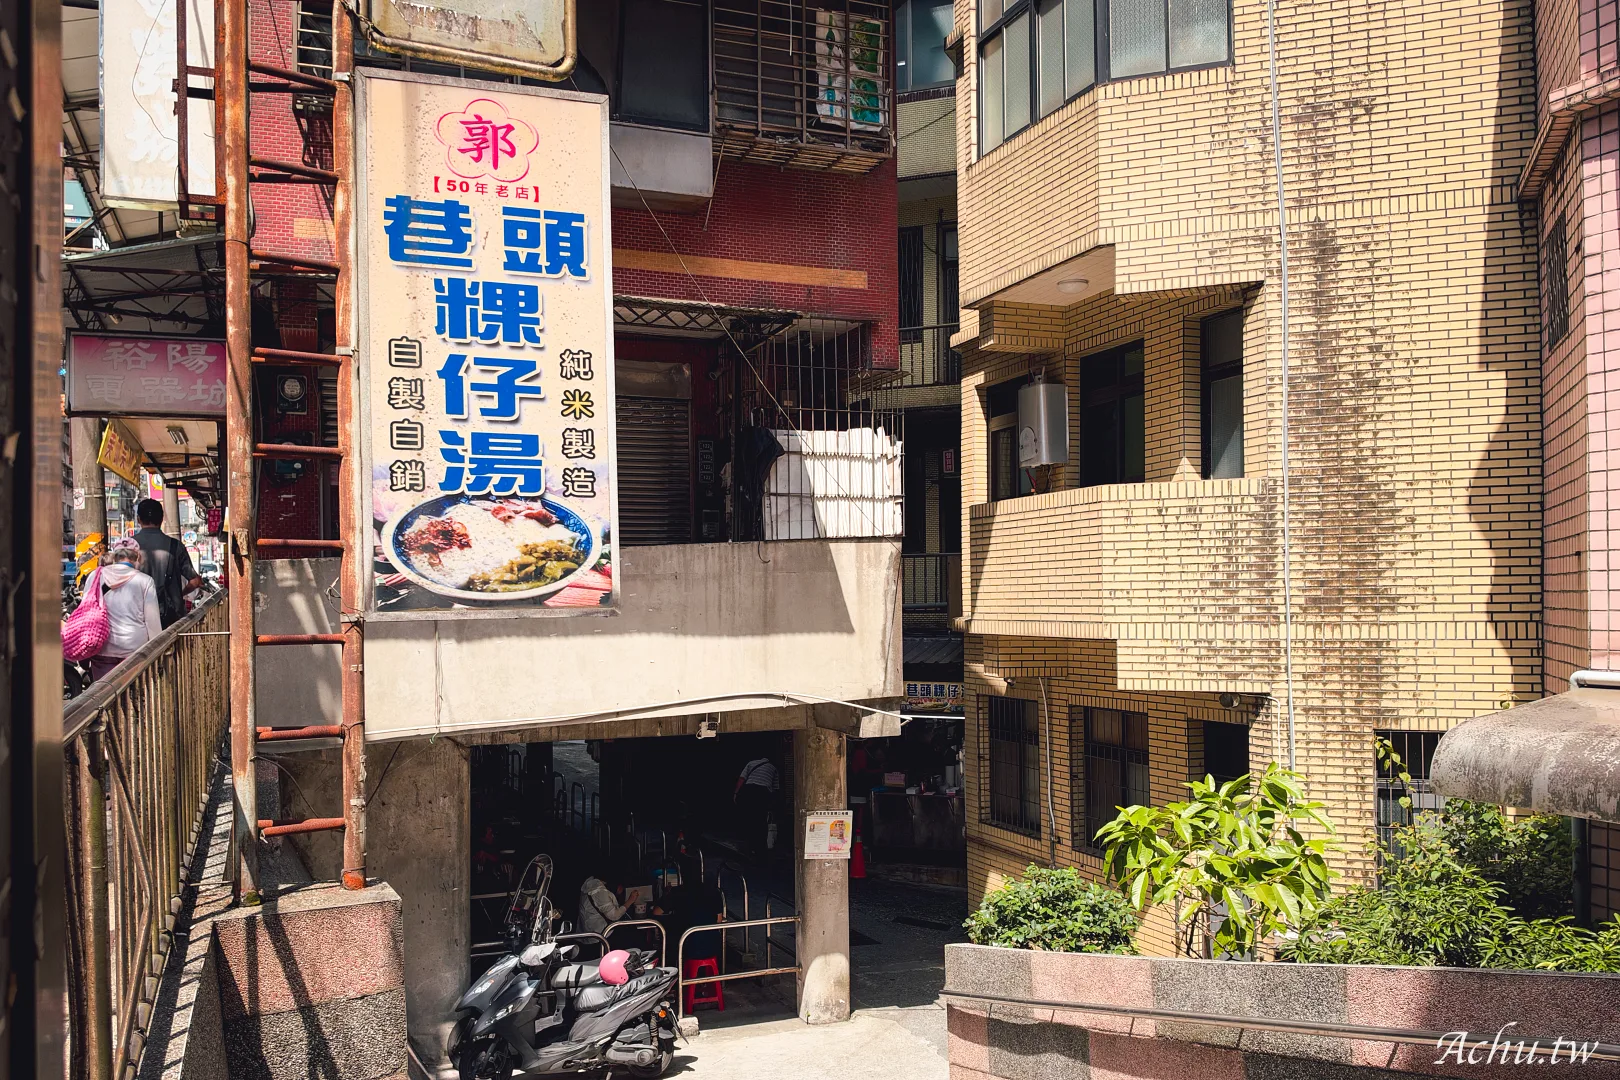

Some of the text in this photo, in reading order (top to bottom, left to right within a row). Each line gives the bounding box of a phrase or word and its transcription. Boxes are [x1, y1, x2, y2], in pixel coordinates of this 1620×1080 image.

[457, 114, 516, 170] 郭
[102, 341, 217, 375] 裕陽
[86, 374, 226, 408] 電器城
[388, 336, 425, 492] 自製自銷
[560, 349, 596, 498] 純米製造
[906, 683, 964, 698] 巷頭粿仔
